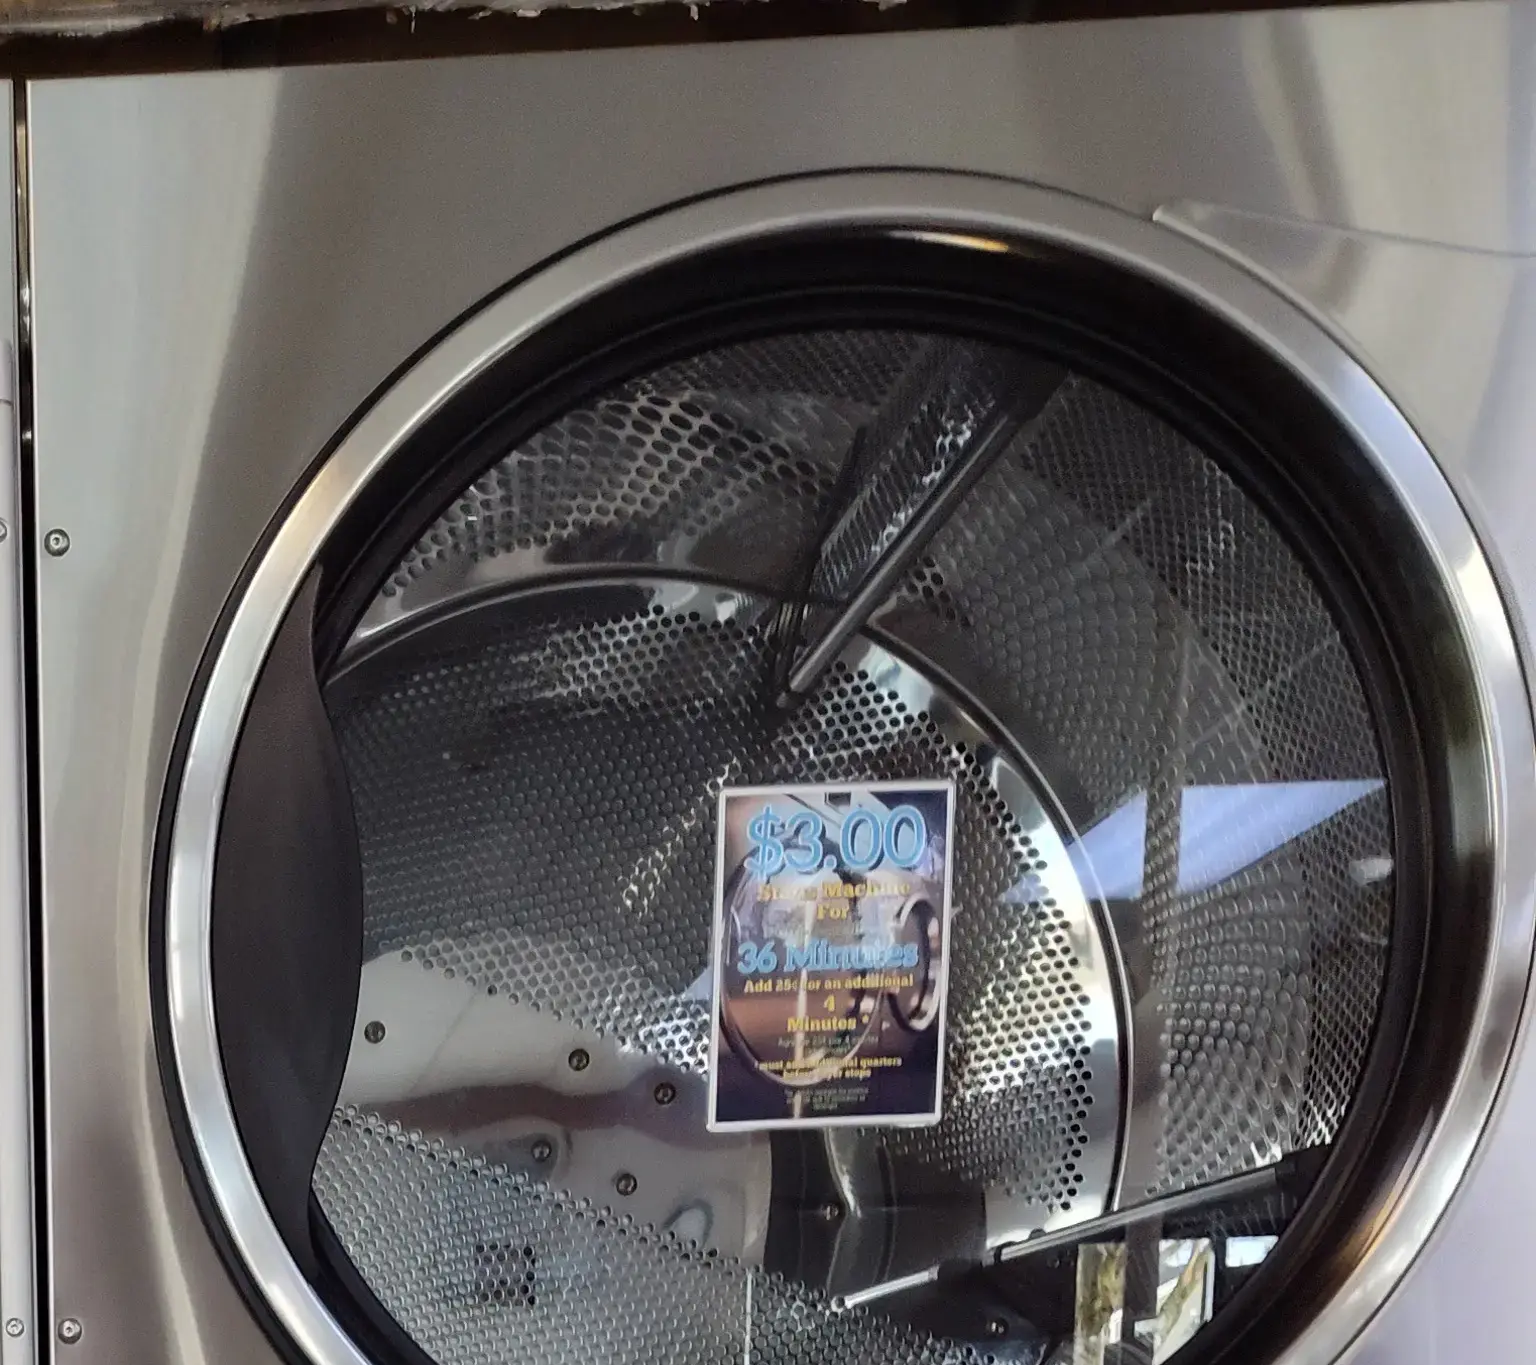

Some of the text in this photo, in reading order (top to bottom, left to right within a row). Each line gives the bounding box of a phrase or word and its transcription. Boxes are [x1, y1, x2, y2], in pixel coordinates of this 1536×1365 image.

[744, 804, 926, 881] $3.00
[821, 878, 911, 898] Machine
[817, 903, 849, 920] For
[737, 937, 919, 974] 36 Minutes
[744, 978, 772, 993] Add
[824, 978, 841, 989] an
[844, 973, 914, 989] additional
[823, 994, 835, 1012] 4
[787, 1016, 857, 1033] Minutes
[860, 1057, 903, 1071] quarters
